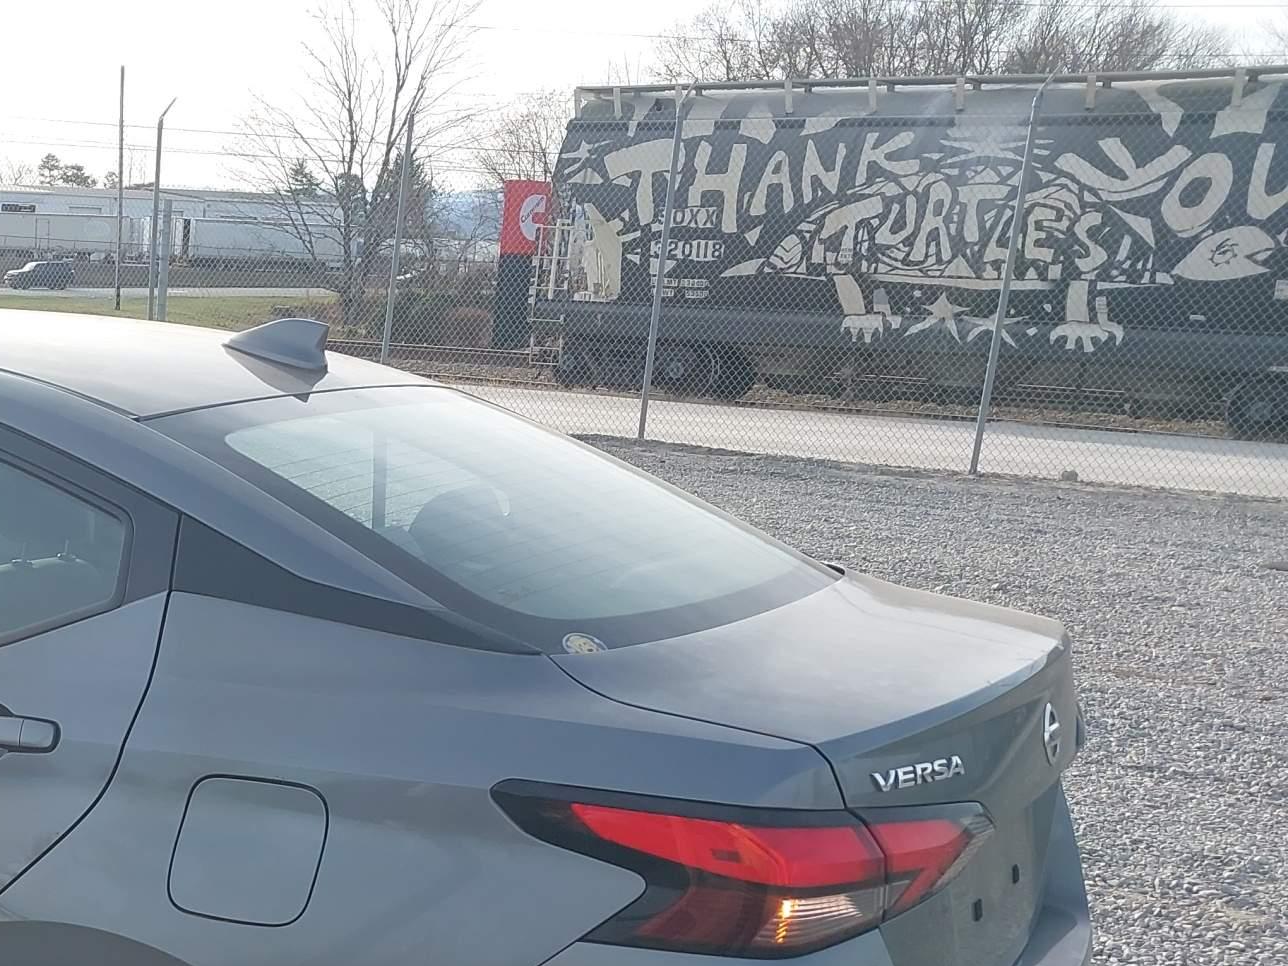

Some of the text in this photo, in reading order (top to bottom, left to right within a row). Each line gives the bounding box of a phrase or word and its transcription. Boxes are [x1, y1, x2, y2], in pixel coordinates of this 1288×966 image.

[604, 131, 920, 233] THANK
[819, 181, 1108, 273] TURTLES
[872, 755, 965, 792] VERSA
